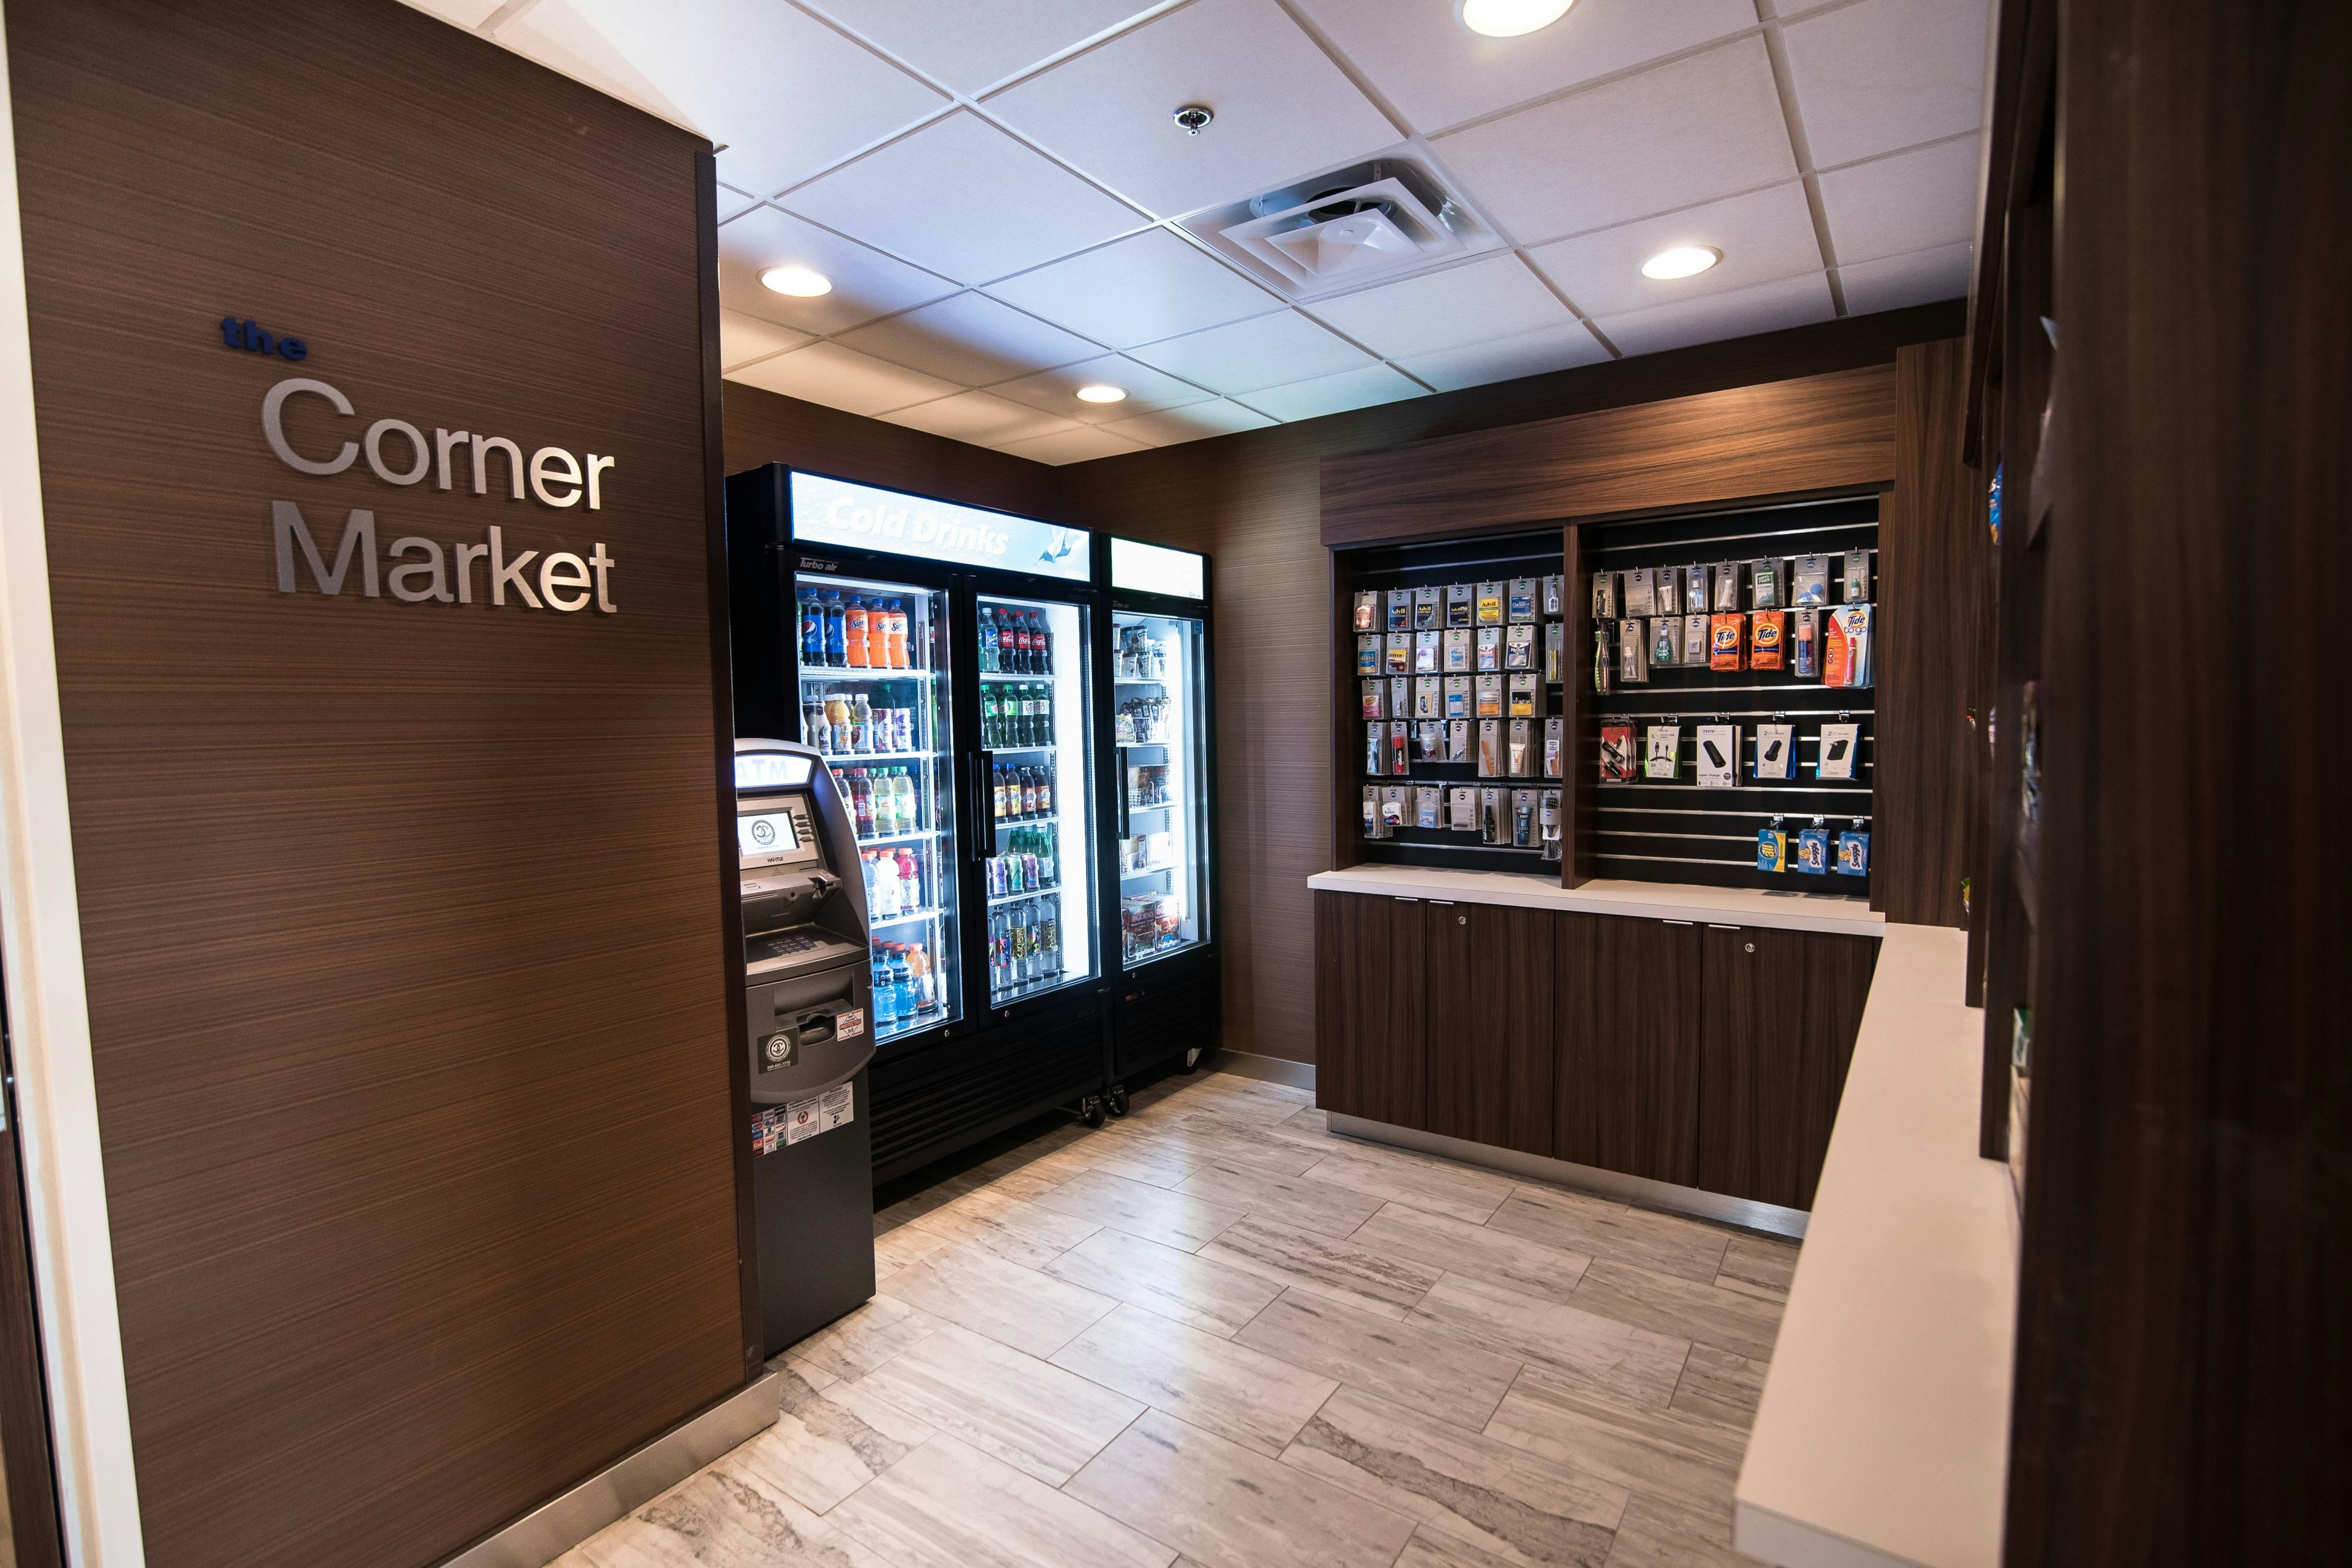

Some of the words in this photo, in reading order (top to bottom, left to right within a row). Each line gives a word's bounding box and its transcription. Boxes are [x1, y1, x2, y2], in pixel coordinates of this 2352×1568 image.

[219, 316, 307, 361] the
[261, 378, 614, 510] Corner
[828, 498, 910, 539] Cold
[911, 511, 1010, 556] Drinks
[272, 500, 617, 613] Market
[800, 557, 824, 570] Turbo
[825, 563, 838, 571] air
[1848, 615, 1865, 627] Tide
[1717, 631, 1735, 643] Tide
[1758, 628, 1778, 641] Tide
[1855, 627, 1867, 636] go
[1762, 844, 1775, 858] all
[1810, 842, 1820, 866] Snuggle
[1850, 844, 1860, 868] Snuggle
[1132, 911, 1153, 922] DIGIORNO
[840, 1020, 861, 1029] PROTECTED
